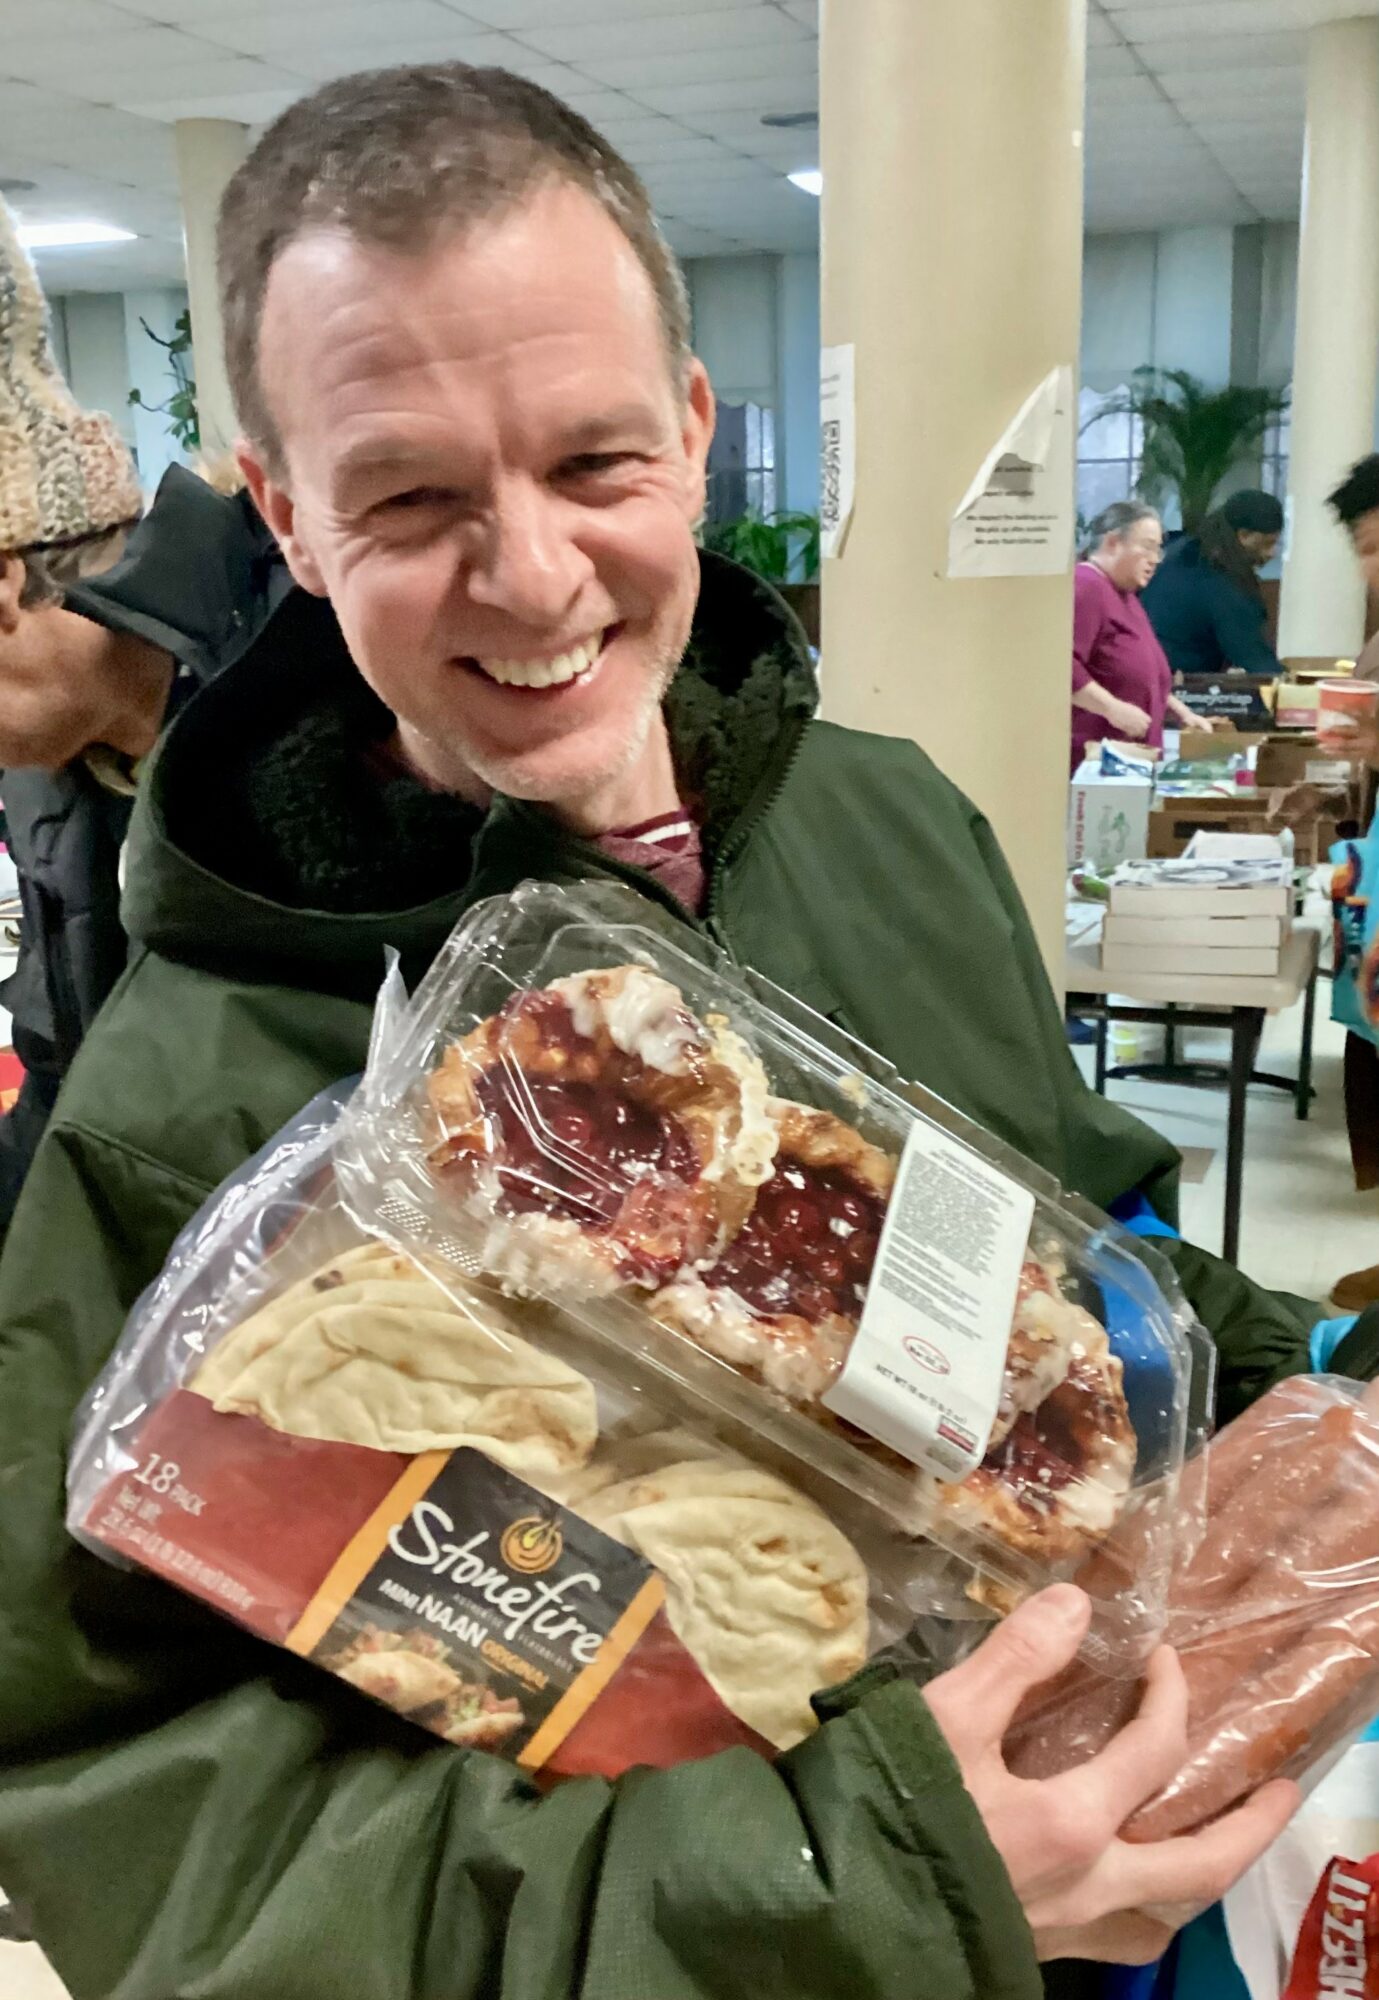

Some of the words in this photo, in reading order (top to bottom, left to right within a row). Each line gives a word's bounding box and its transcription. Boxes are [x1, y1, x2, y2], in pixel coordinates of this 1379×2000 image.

[133, 1452, 180, 1494] 18
[168, 1483, 208, 1517] PACK
[378, 1578, 422, 1610] MINI
[416, 1594, 490, 1648] NAAN
[480, 1638, 550, 1690] ORIGINAL
[388, 1501, 602, 1664] Stonefire
